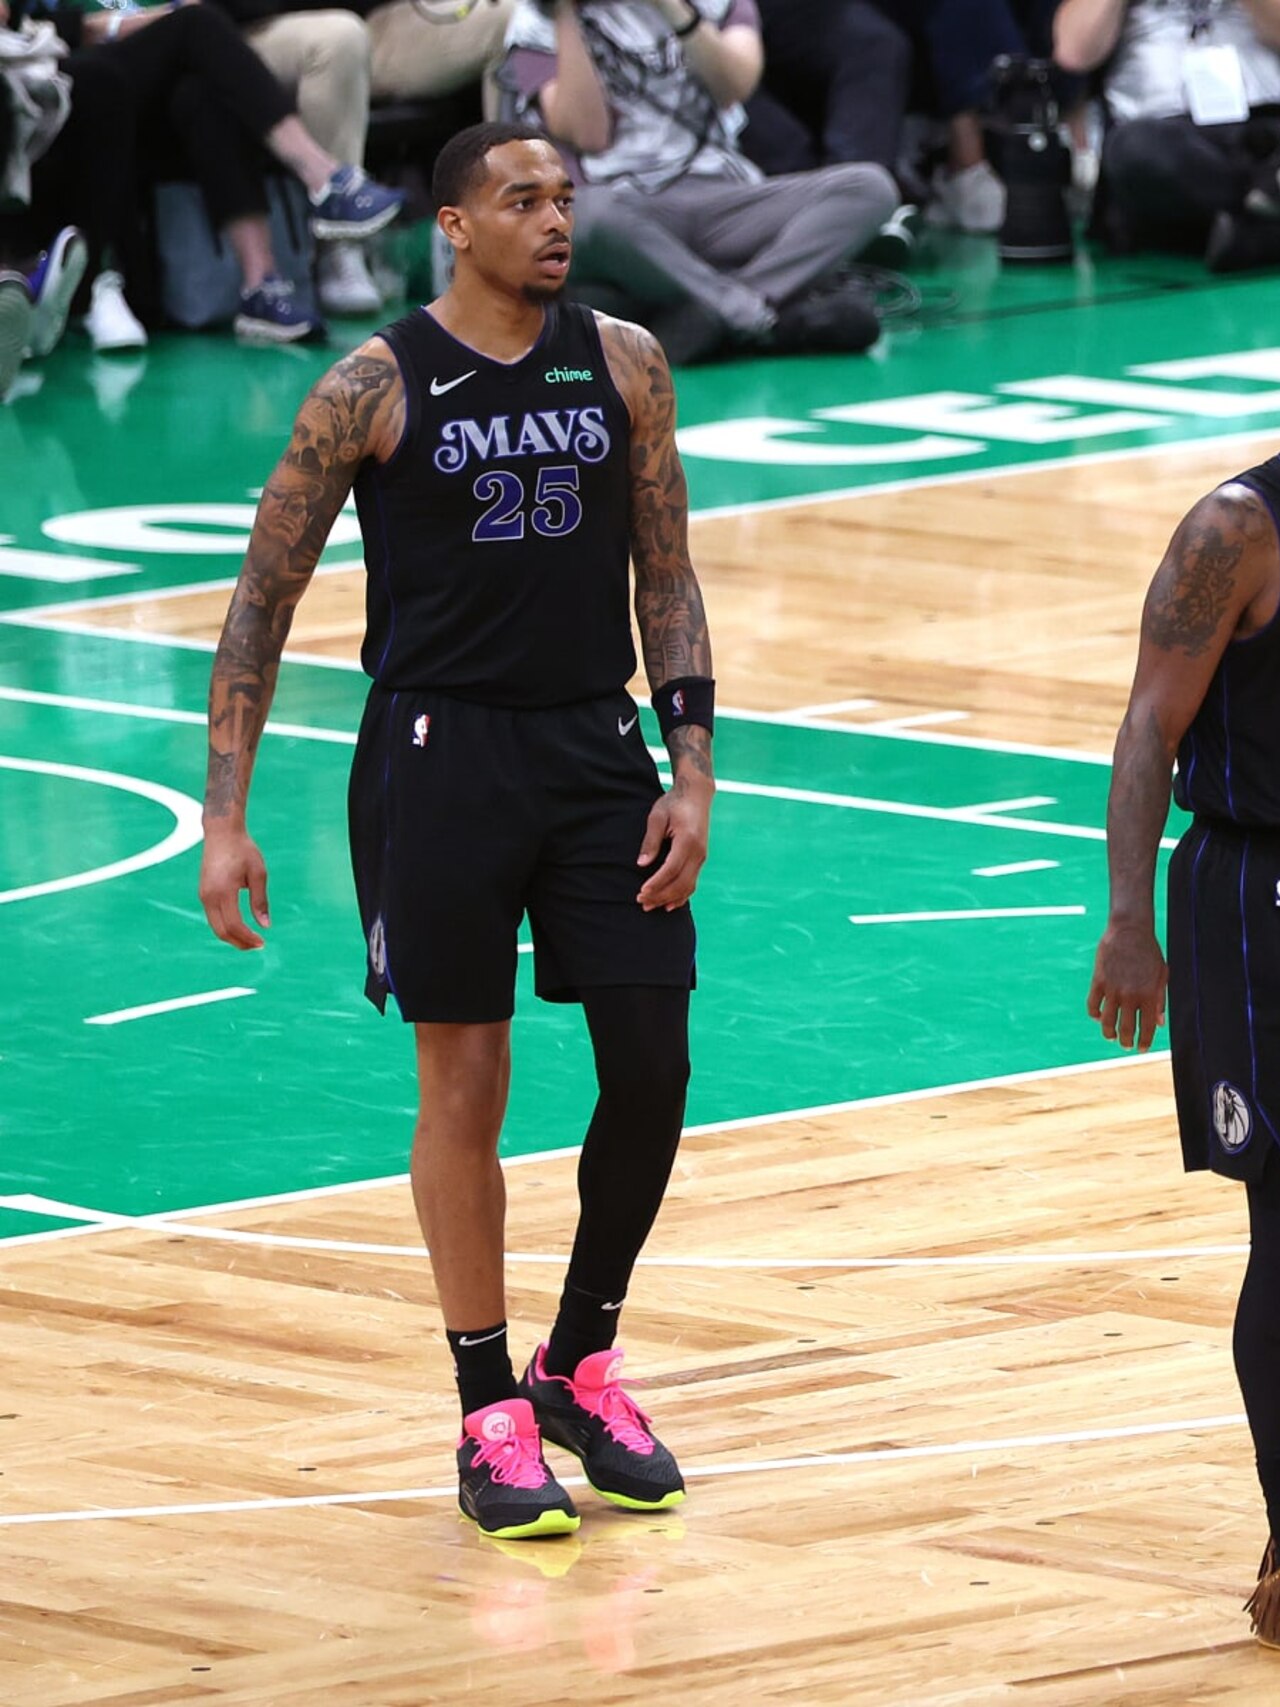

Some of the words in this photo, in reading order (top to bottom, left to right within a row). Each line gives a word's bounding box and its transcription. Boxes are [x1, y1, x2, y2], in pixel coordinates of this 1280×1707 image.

[545, 366, 594, 384] chime
[433, 405, 611, 474] MAVS
[471, 464, 583, 542] 25
